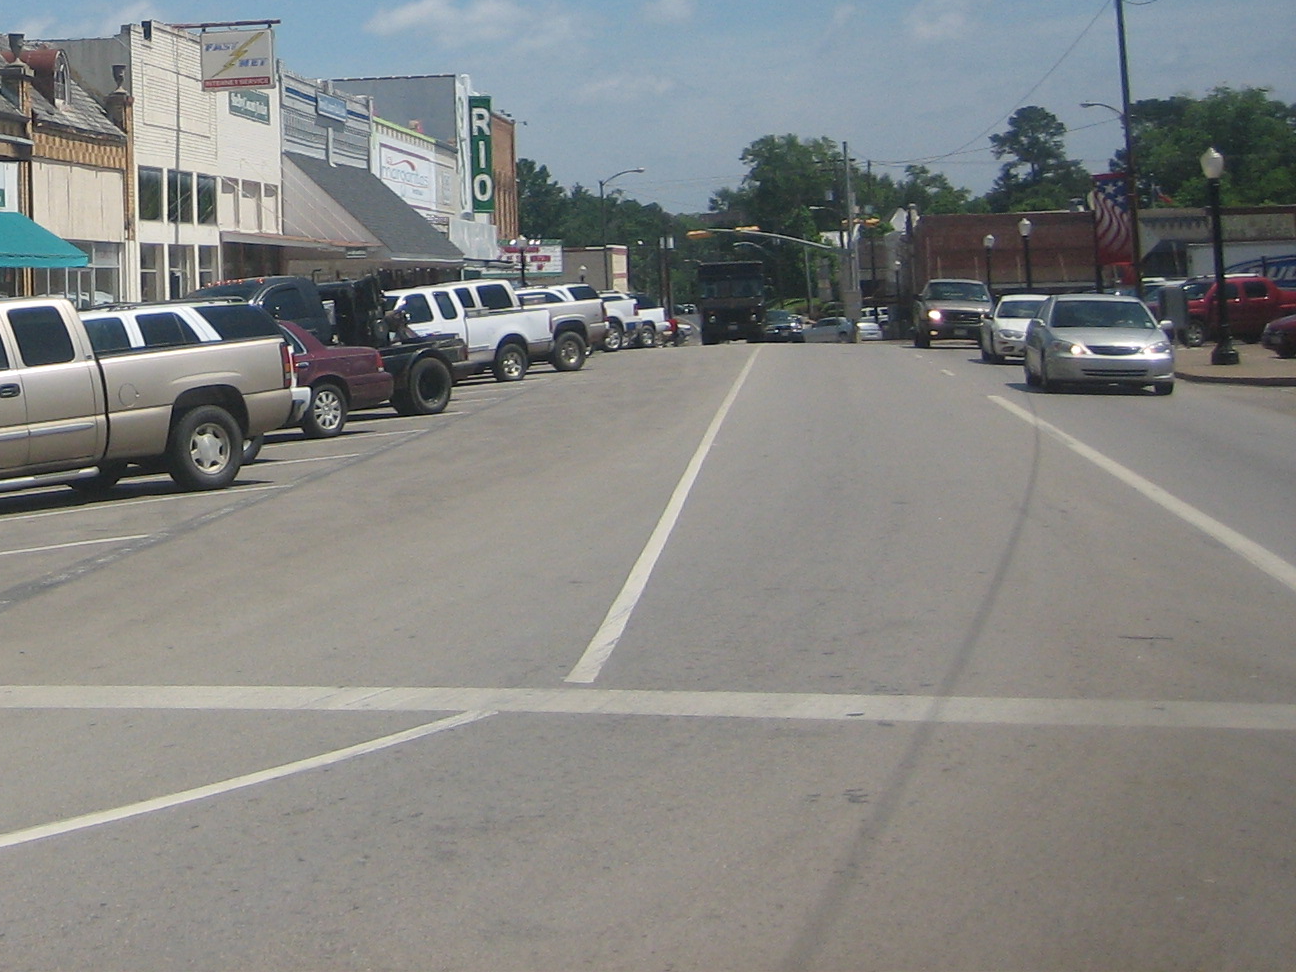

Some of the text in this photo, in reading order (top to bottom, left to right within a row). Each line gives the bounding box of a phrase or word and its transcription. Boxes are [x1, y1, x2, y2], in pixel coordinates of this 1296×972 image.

[205, 41, 239, 52] FAST
[239, 58, 269, 68] NET
[472, 107, 492, 202] RIO
